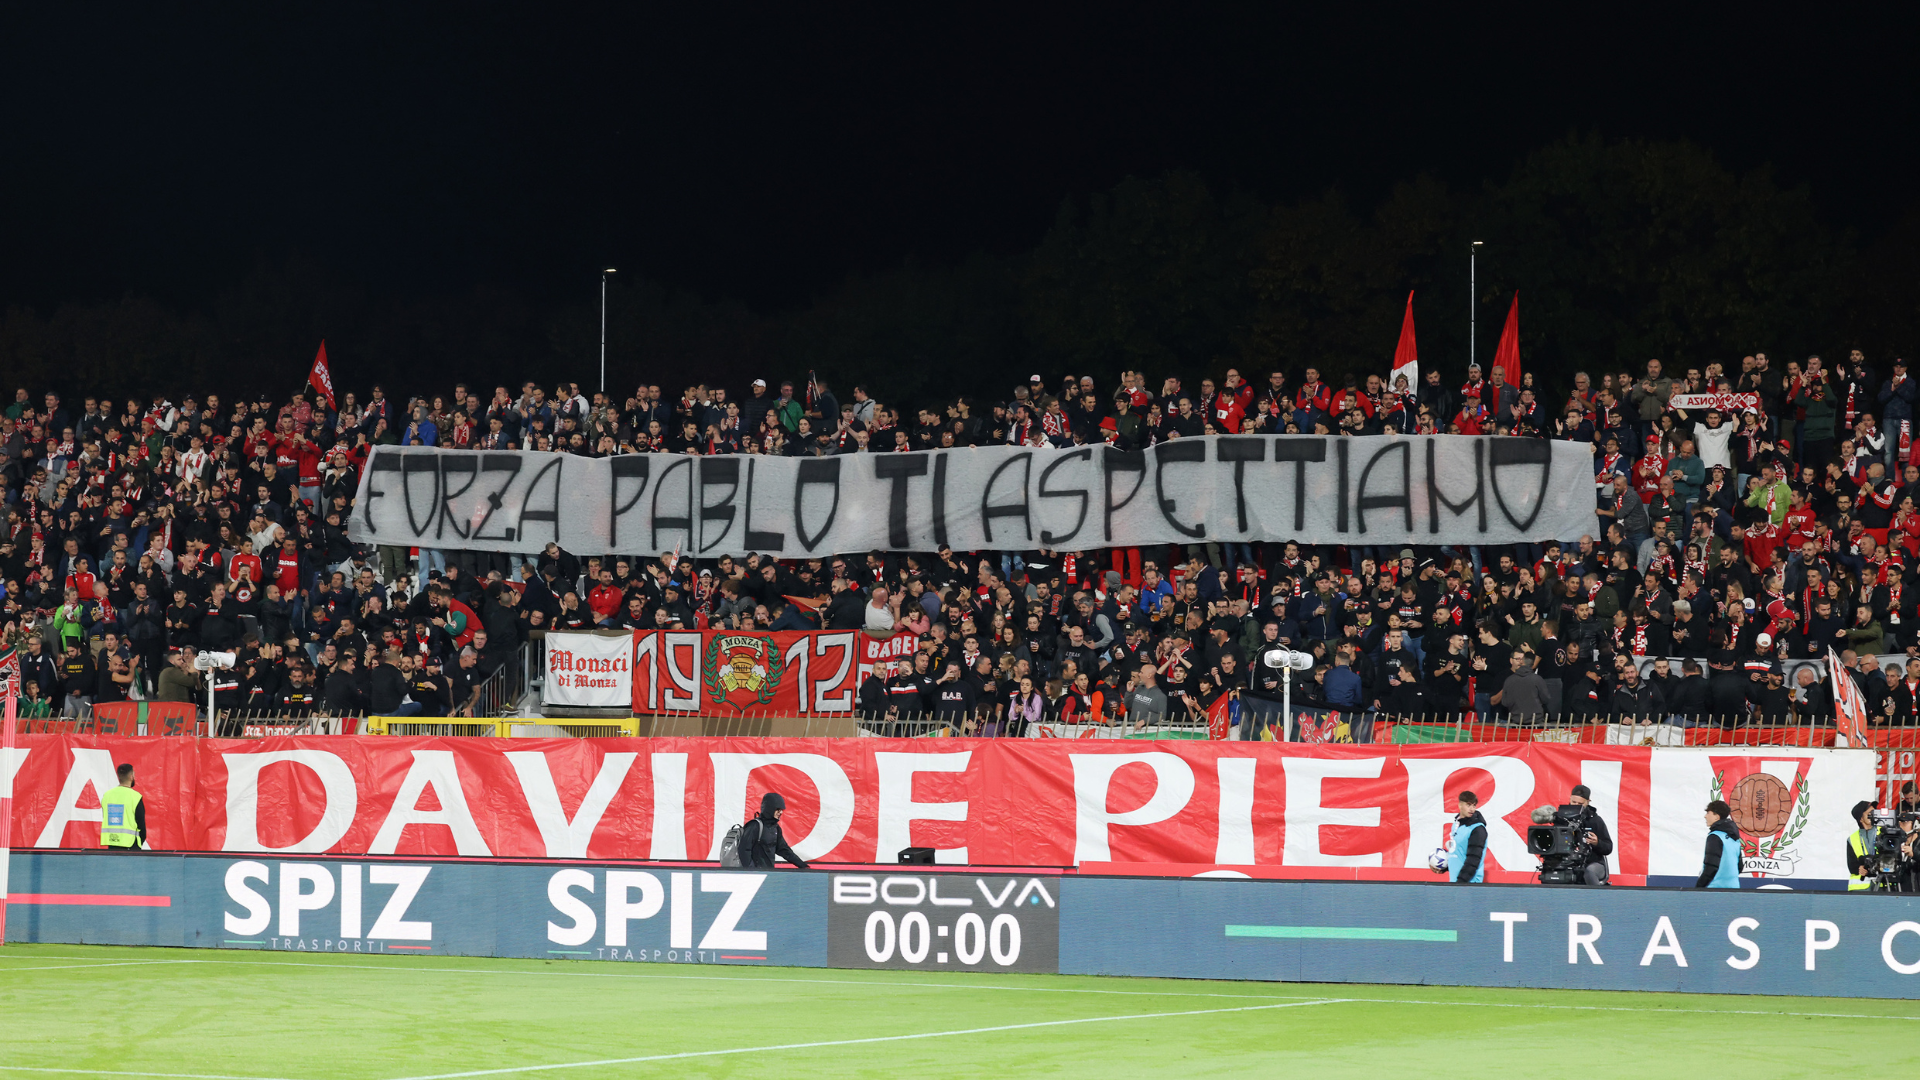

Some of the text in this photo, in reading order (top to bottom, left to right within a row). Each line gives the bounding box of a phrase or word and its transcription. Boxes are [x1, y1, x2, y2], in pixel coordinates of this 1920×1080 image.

[365, 438, 1551, 553] FORZA PABLO TI ASPETTIAMO
[550, 650, 628, 673] Monaci
[724, 637, 760, 649] MONZA
[558, 674, 617, 688] di Monza
[636, 631, 853, 711] 19 12
[222, 749, 972, 864] DAVIDE
[1068, 750, 1624, 876] PIERI
[1741, 859, 1780, 870] MONZA
[223, 861, 433, 940] SPIZ
[546, 869, 768, 948] SPIZ
[832, 875, 1056, 908] BOLVA
[270, 937, 385, 953] TRASPORTI
[597, 947, 717, 963] TRASPORTI
[864, 910, 1022, 966] 00:00
[1489, 911, 1920, 975] TRASPO
